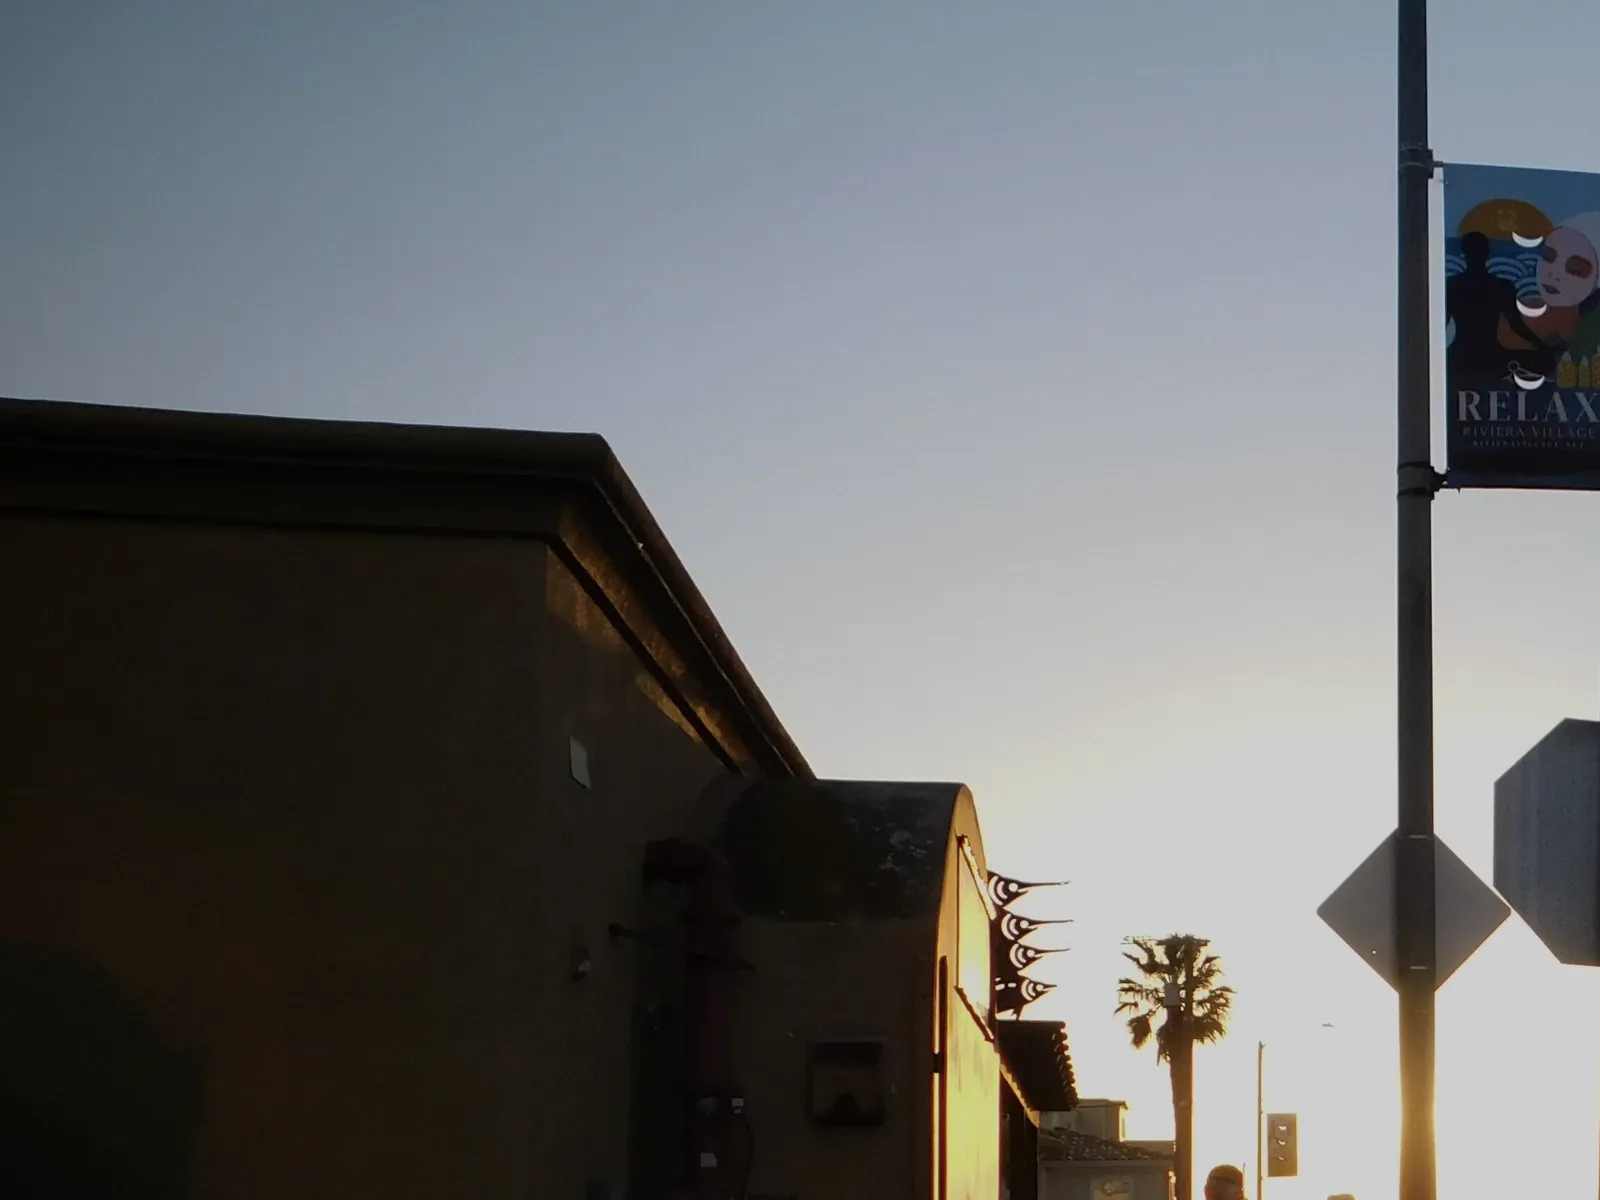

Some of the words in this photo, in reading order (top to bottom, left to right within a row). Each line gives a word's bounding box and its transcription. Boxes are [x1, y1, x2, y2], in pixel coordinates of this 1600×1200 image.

[1457, 389, 1600, 423] RELAX
[1462, 425, 1525, 438] RIVIERA
[1531, 426, 1596, 440] VILLAGE
